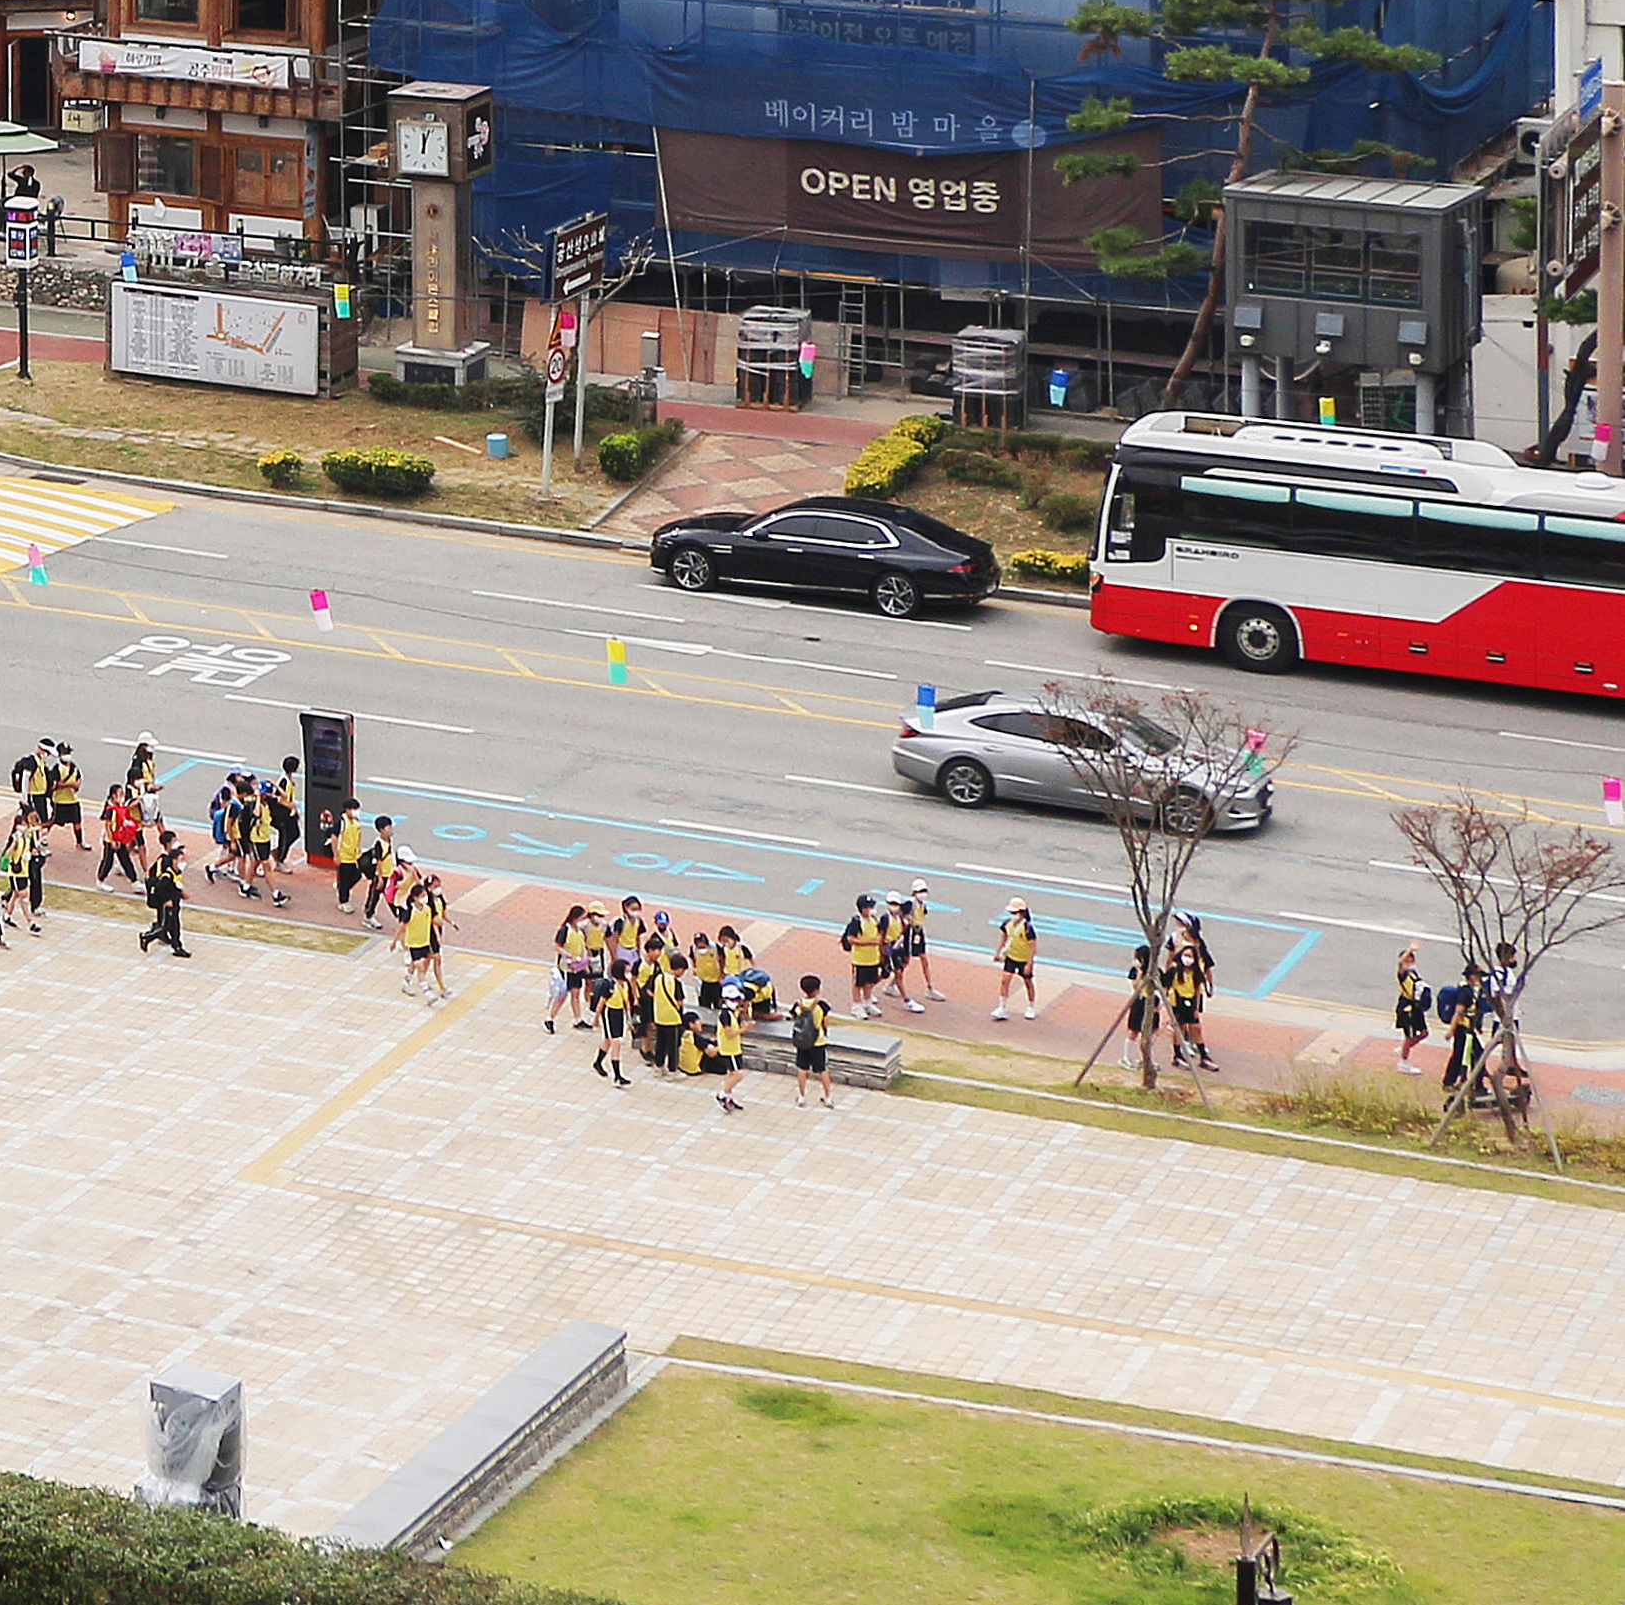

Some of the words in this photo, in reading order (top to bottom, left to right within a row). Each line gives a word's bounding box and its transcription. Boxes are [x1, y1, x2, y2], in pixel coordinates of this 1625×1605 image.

[764, 100, 874, 137] 베이커리
[801, 167, 896, 202] OPEN
[908, 177, 1000, 213] 영업중
